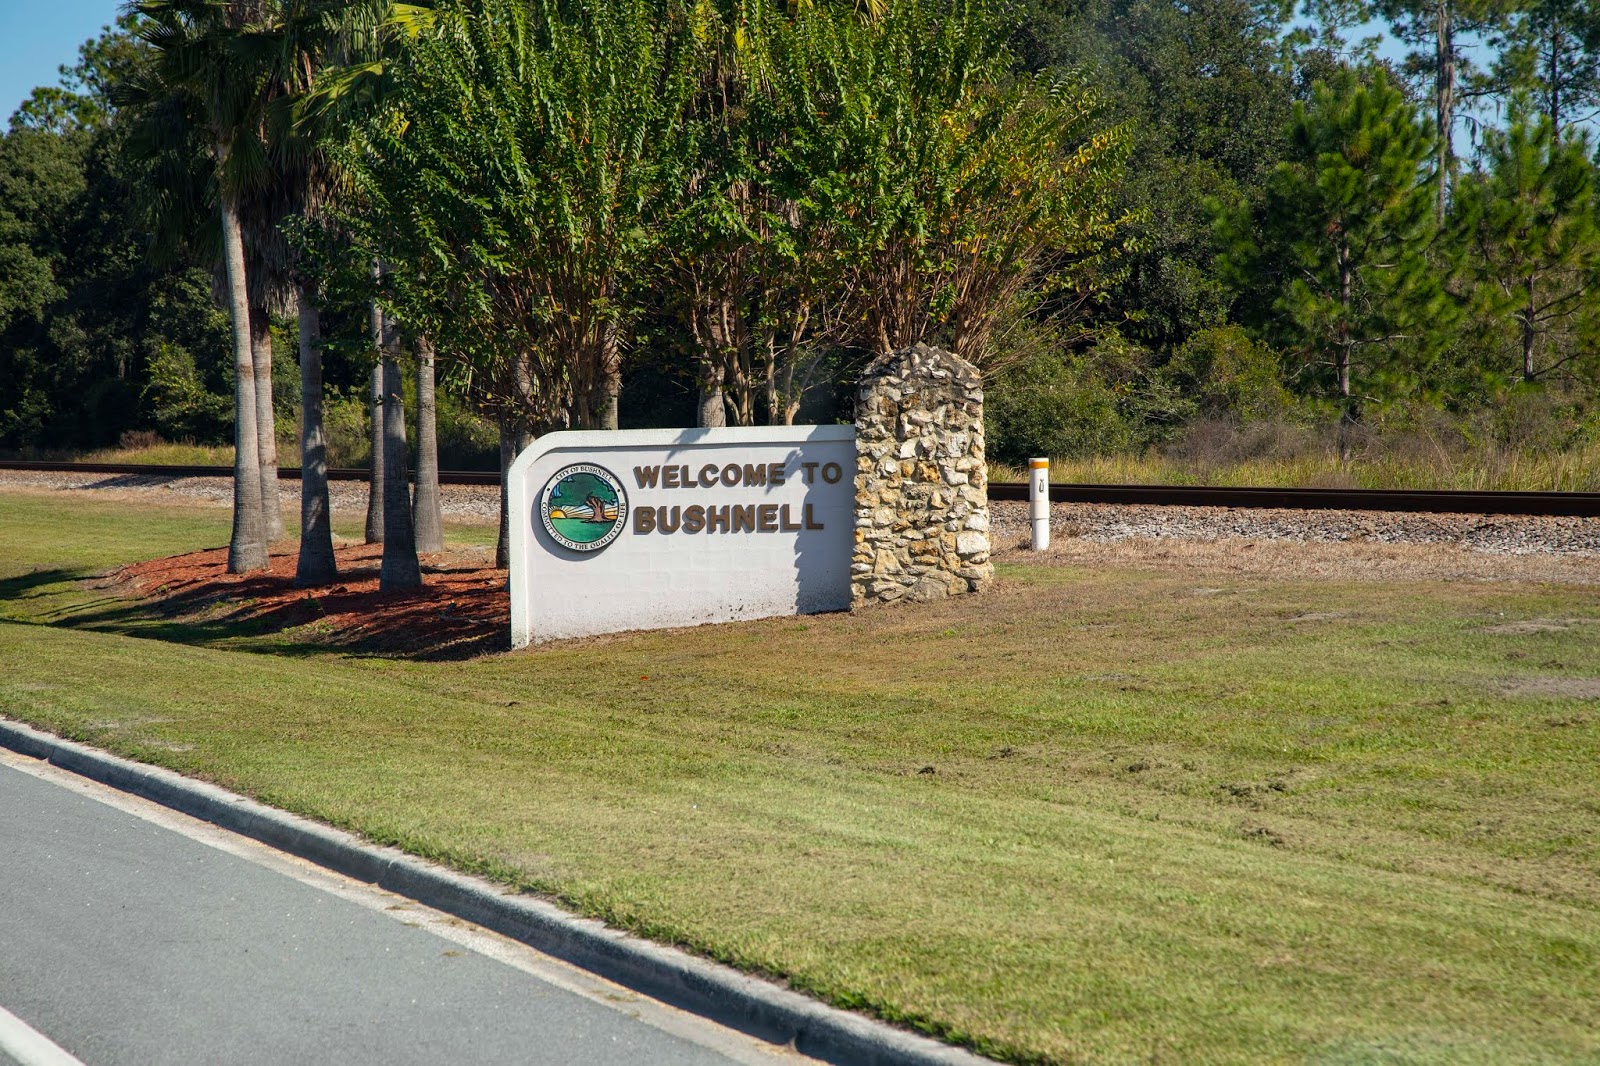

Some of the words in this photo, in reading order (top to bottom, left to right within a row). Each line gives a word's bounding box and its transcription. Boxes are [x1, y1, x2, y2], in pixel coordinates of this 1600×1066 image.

[580, 465, 613, 482] BUSHNELL
[633, 463, 786, 488] WELCOME
[802, 462, 843, 484] TO
[633, 504, 824, 534] BUSHNELL
[563, 540, 574, 548] TO
